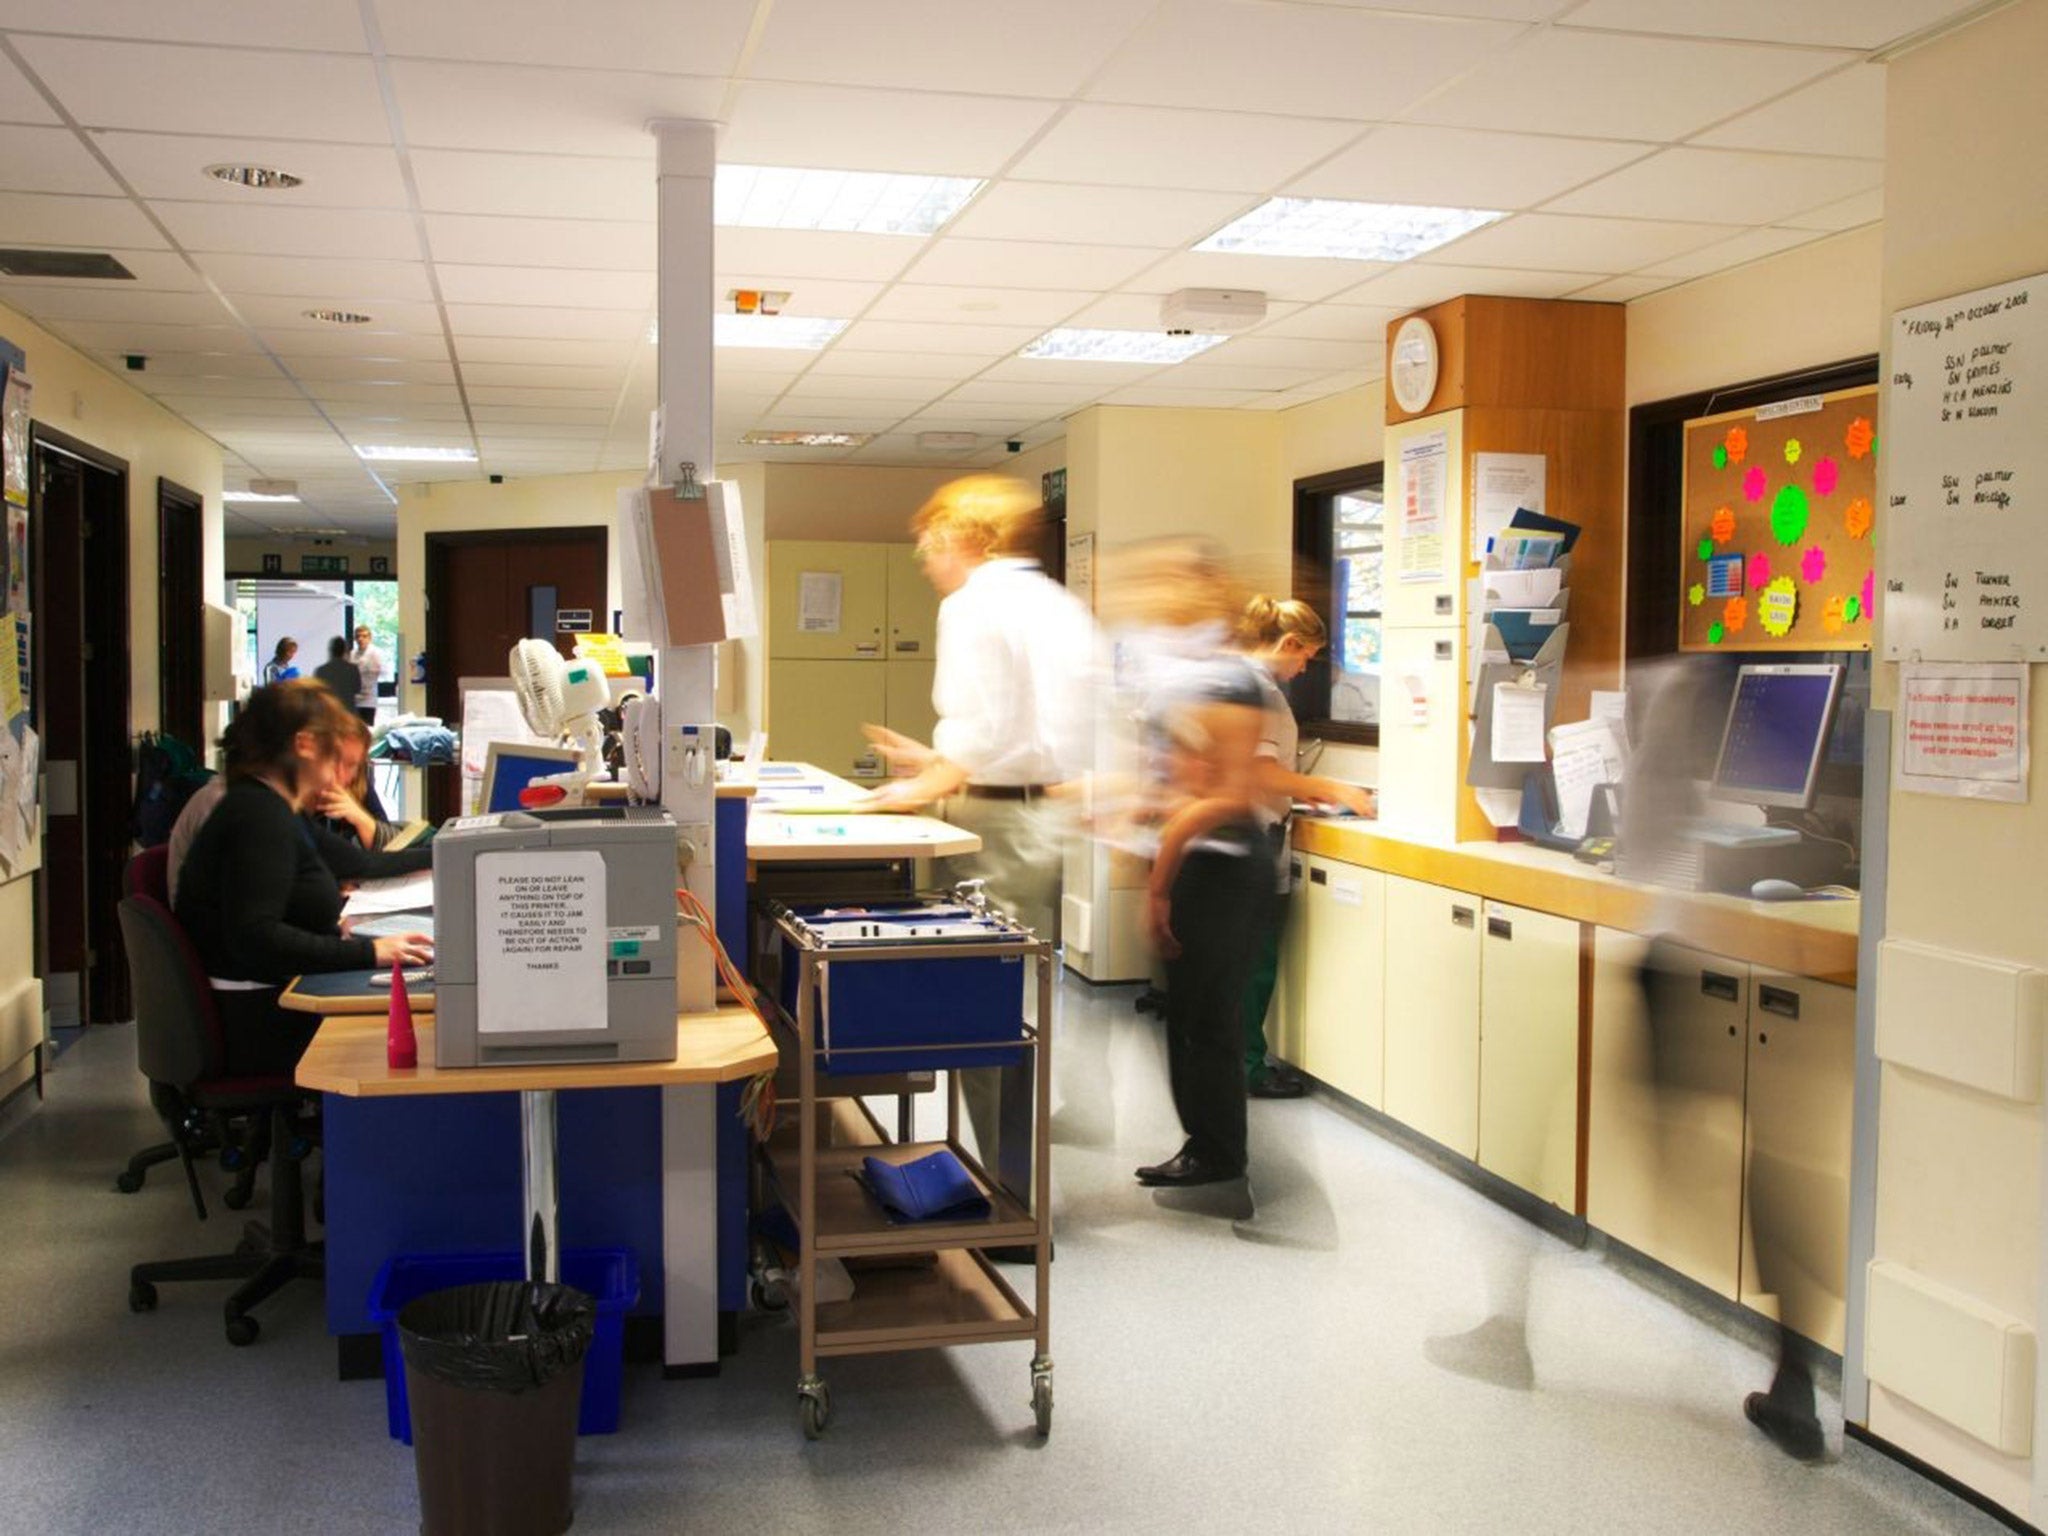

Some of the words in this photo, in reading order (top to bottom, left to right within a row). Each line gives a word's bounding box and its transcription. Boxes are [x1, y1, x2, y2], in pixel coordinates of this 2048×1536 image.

[267, 557, 278, 569] H
[372, 559, 386, 572] G
[498, 876, 530, 884] PLEASE
[531, 876, 543, 884] DO
[544, 876, 562, 884] NOT
[563, 875, 585, 883] LEAN
[515, 885, 527, 893] ON
[556, 893, 572, 901] TOP
[573, 892, 584, 900] OF
[511, 902, 529, 910] THIS
[509, 911, 543, 919] CAUSES
[518, 920, 547, 928] EASILY
[546, 928, 574, 936] NEEDS
[576, 927, 587, 935] TO
[502, 946, 534, 955] (AGAIN)
